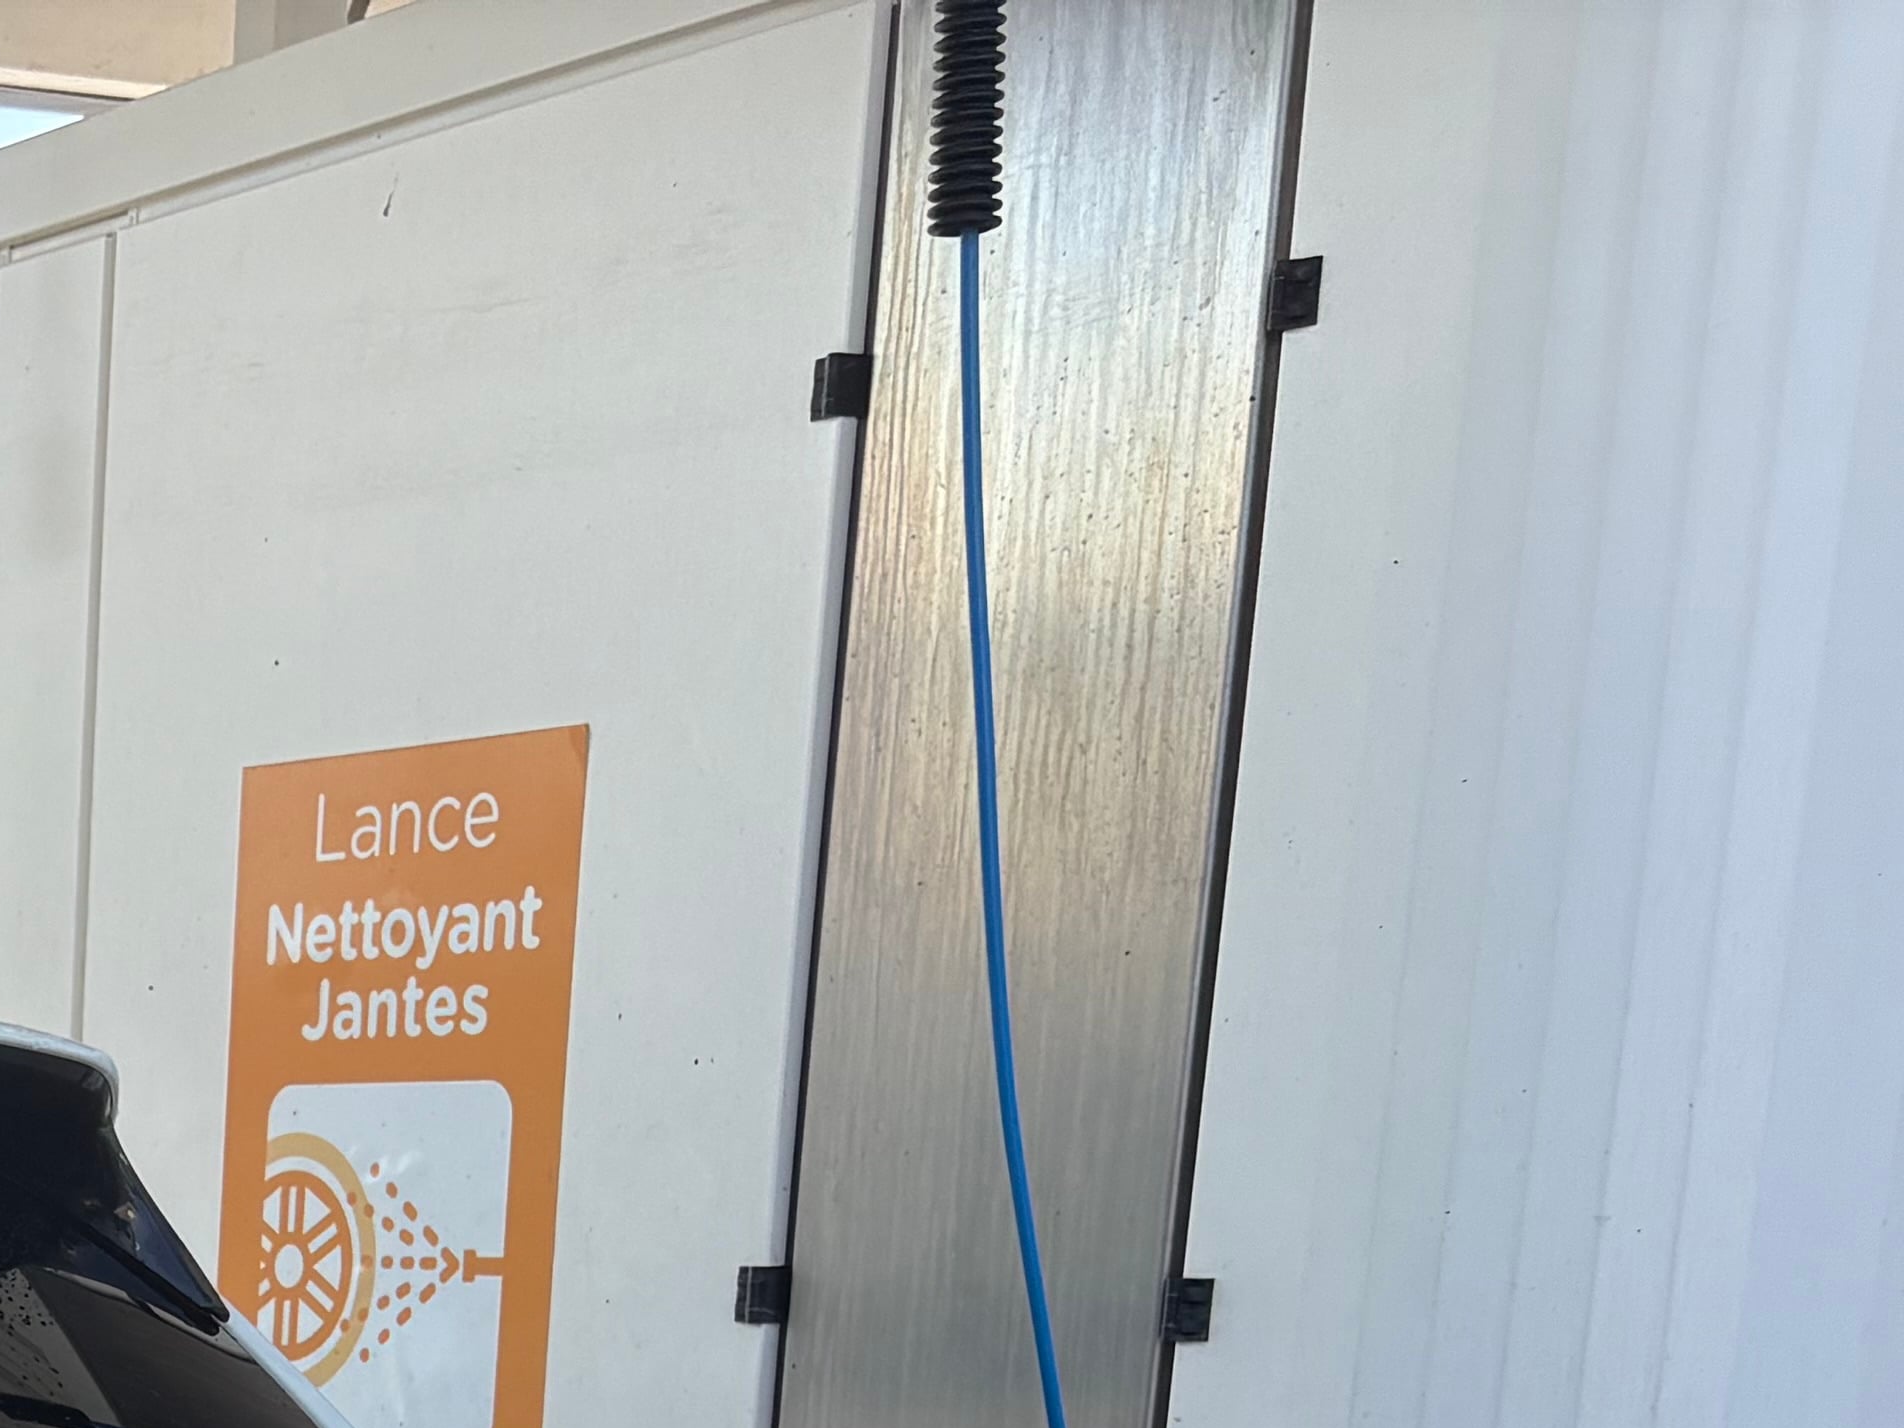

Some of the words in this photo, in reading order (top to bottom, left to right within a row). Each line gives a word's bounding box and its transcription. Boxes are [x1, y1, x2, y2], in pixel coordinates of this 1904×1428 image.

[315, 792, 500, 862] Lance
[266, 885, 543, 970] Nettoyant
[301, 976, 489, 1041] Jantes
